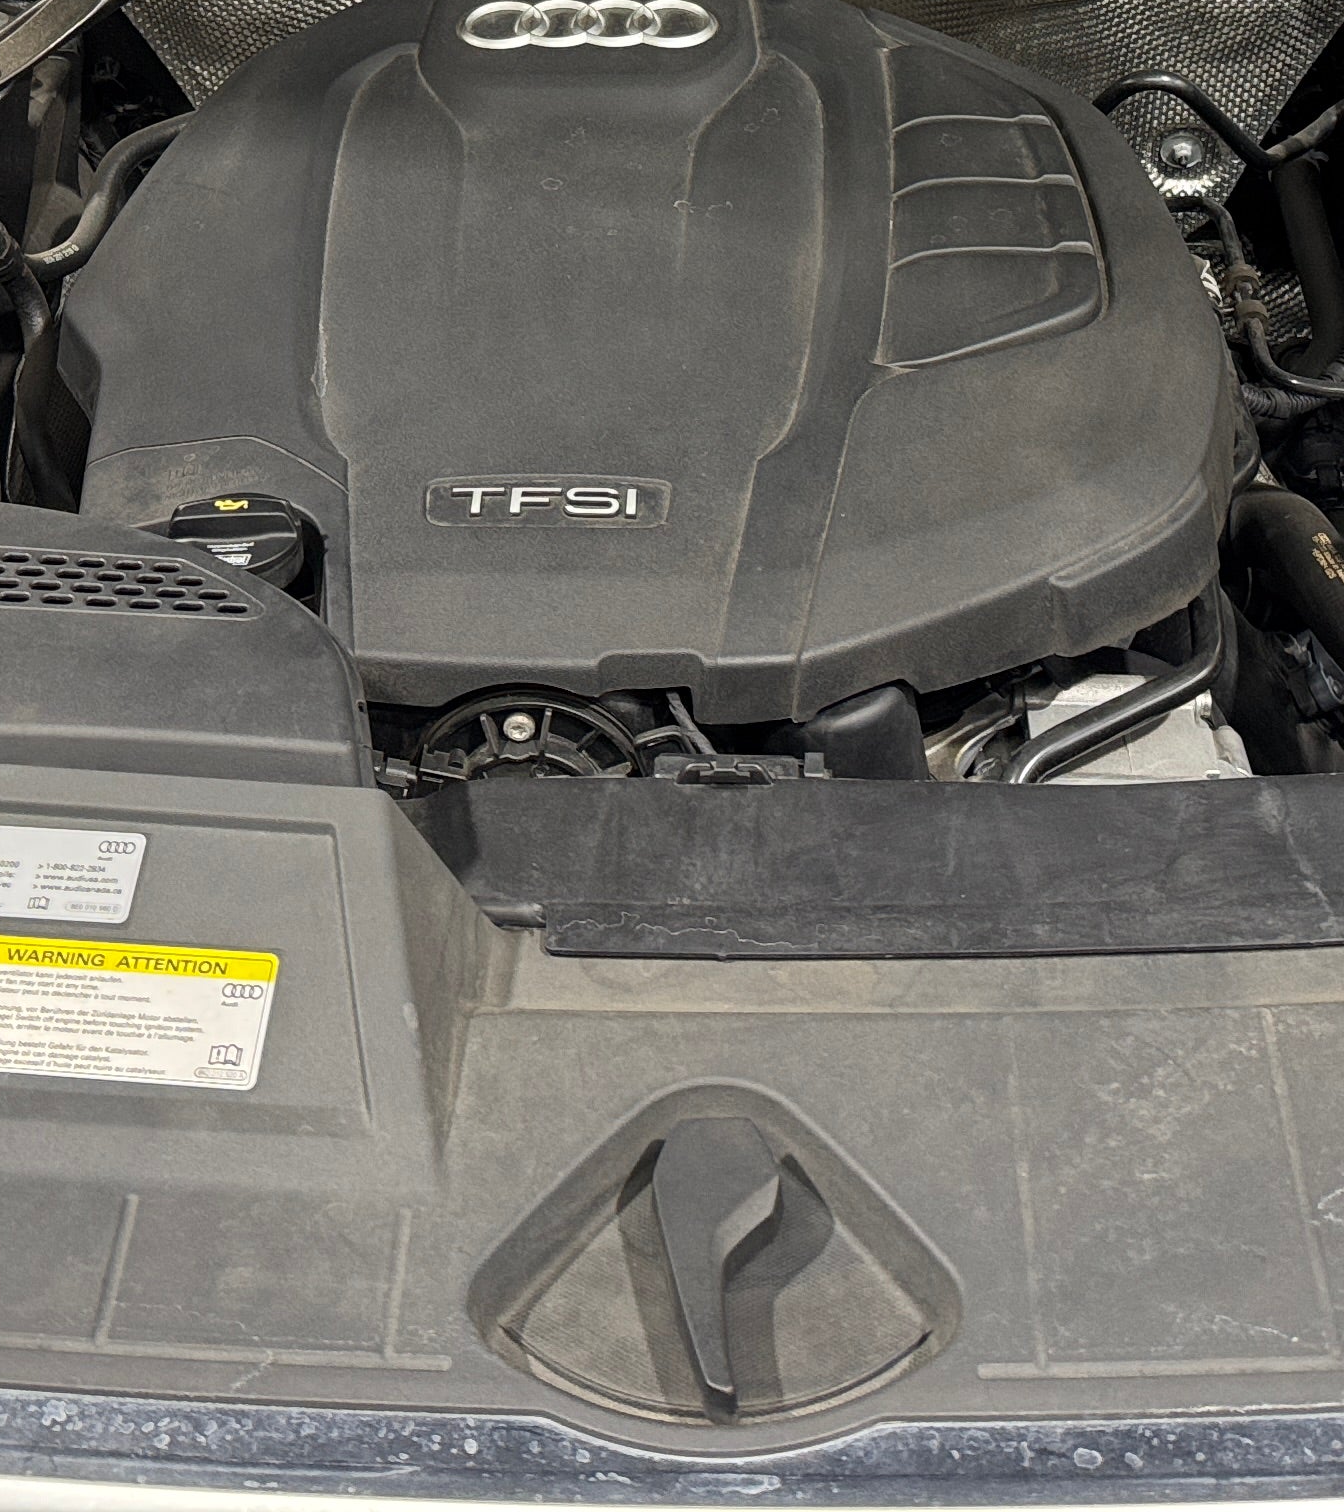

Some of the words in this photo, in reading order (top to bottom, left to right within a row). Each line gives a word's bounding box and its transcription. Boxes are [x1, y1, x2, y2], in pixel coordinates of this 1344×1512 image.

[451, 487, 638, 519] TFSI
[7, 948, 105, 967] WARNING
[115, 956, 228, 976] ATTENTION
[14, 1013, 41, 1022] Switch
[54, 1017, 81, 1026] engine
[81, 1018, 107, 1026] before
[107, 1020, 142, 1030] touching
